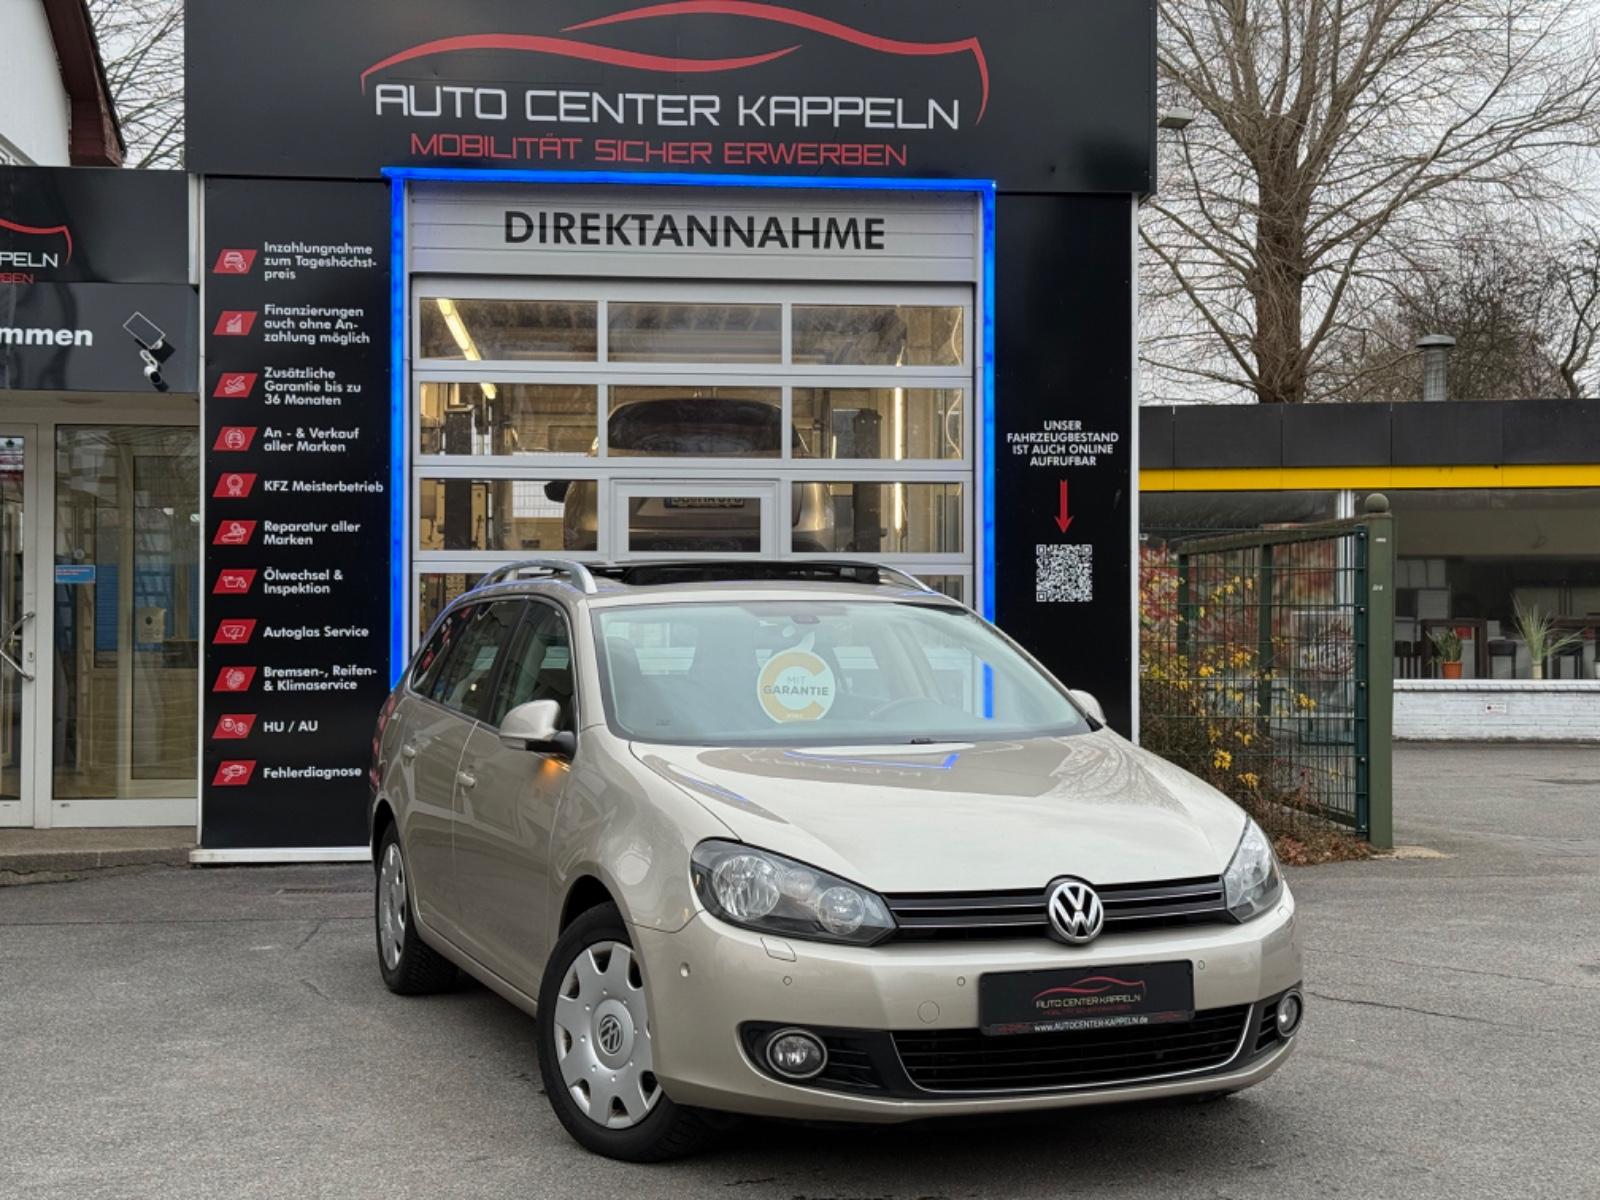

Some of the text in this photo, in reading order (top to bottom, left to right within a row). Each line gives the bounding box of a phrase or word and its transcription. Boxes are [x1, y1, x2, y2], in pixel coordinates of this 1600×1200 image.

[375, 84, 960, 130] AUTO CENTER KAPPELN
[410, 132, 908, 167] MOBILITÄT SICHER ERWERBEN
[504, 211, 885, 250] DIREKTANNAHME
[264, 241, 373, 255] Inzahlungnahme
[264, 255, 377, 269] zum Tageshöchst-
[264, 268, 296, 281] preis
[264, 304, 364, 318] Finanzierungen
[264, 317, 359, 330] auch ohne An-
[264, 331, 370, 346] zahlung möglich
[264, 366, 336, 379] Zusätzliche
[264, 380, 361, 393] Garantie bis zu
[264, 393, 342, 406] 36 Monaten
[1043, 420, 1082, 431] UNSER
[295, 427, 305, 439] &
[309, 427, 360, 439] Verkauf
[1007, 432, 1119, 443] FAHRZEUGBESTAND
[264, 440, 346, 452] aller Marken
[1012, 444, 1114, 455] IST AUCH ONLINE
[1029, 456, 1097, 466] AUFRUFBAR
[264, 480, 384, 493] KFZ Meisterbetrieb
[264, 520, 361, 535] Reparatur aller
[264, 534, 313, 545] Marken
[264, 566, 344, 581] Ölwechsel &
[264, 582, 331, 597] Inspektion
[264, 625, 369, 640] Autoglas Service
[264, 664, 377, 679] Bremsen-, Reifen-
[264, 679, 358, 691] & Klimaservice
[787, 676, 806, 684] MIT
[763, 684, 829, 696] GARANTIE
[264, 720, 318, 733] HU / AU
[264, 766, 362, 780] Fehlerdiagnose
[1035, 993, 1142, 1009] AUTO CENTER KAPPELN
